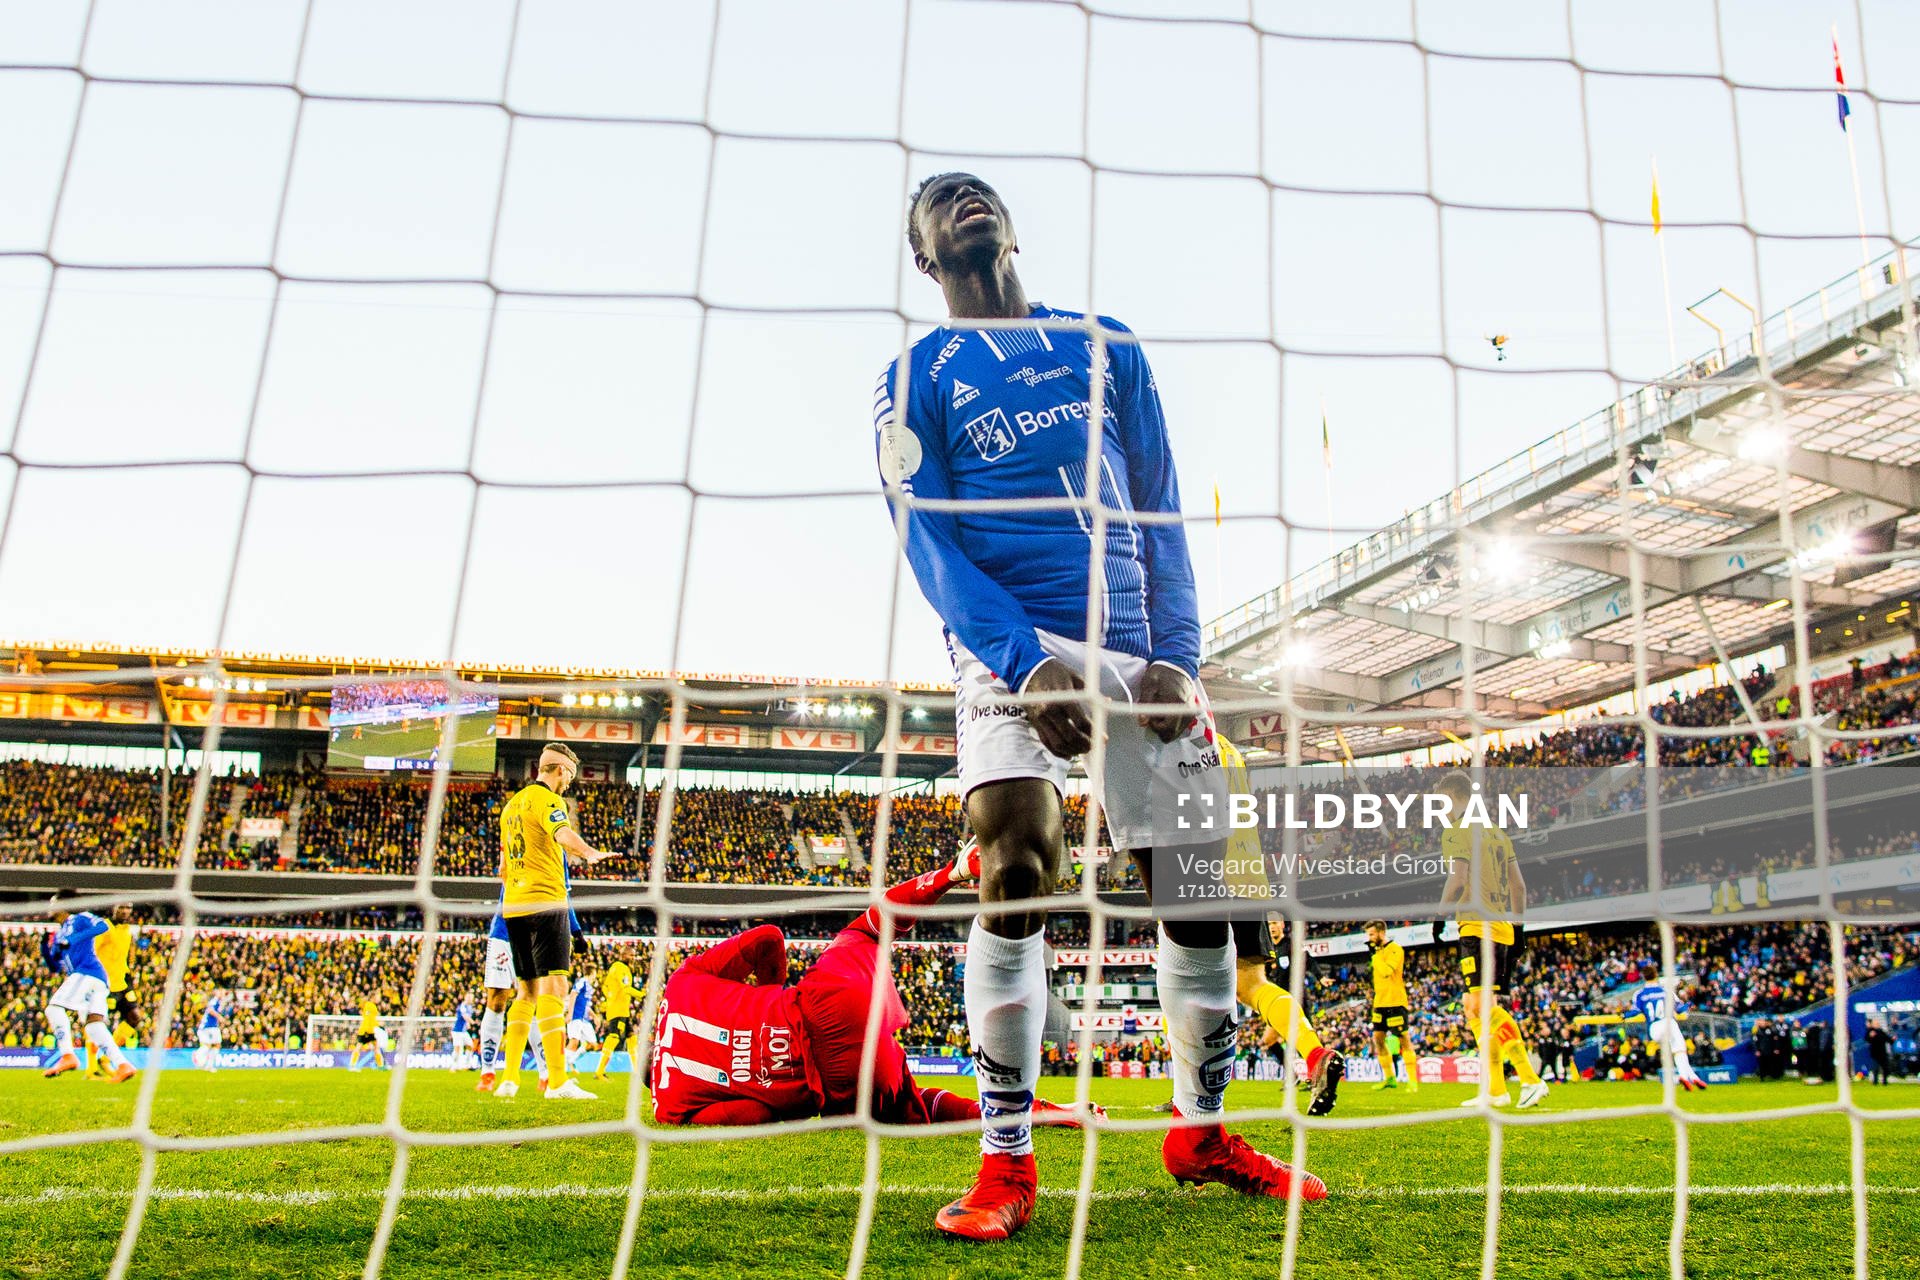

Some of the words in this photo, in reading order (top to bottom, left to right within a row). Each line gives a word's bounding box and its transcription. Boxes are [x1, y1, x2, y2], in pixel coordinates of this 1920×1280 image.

[952, 388, 981, 410] SELECT
[1420, 666, 1445, 684] telenor
[66, 697, 147, 720] VG
[187, 704, 263, 727] VG
[971, 705, 991, 721] Ove
[556, 720, 632, 740] VG
[671, 724, 738, 745] VG
[784, 730, 855, 750] VG
[897, 733, 955, 752] VG
[1178, 761, 1202, 779] Ove
[1104, 953, 1143, 964] VG
[1645, 1001, 1667, 1021] 14
[658, 1012, 731, 1089] 77
[731, 1029, 753, 1082] ORIGI
[768, 1027, 791, 1071] MOT
[215, 1053, 272, 1068] NORSK
